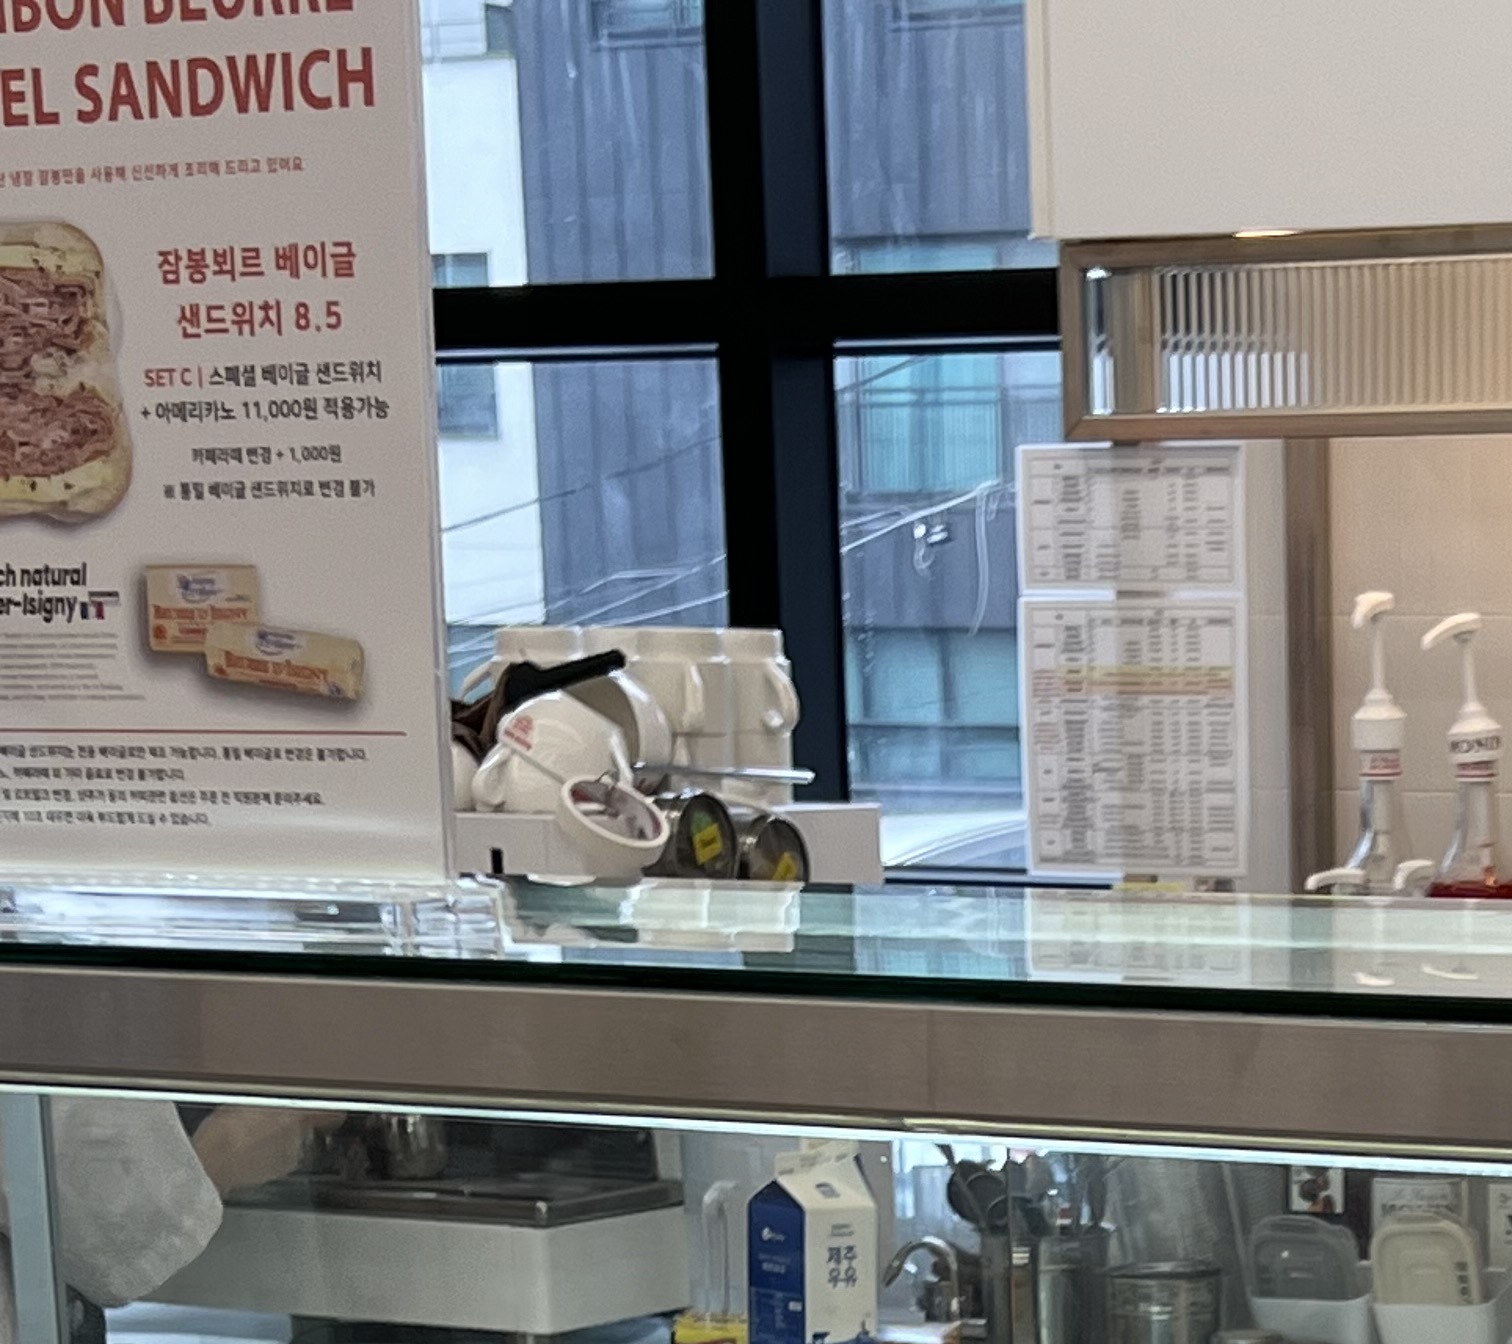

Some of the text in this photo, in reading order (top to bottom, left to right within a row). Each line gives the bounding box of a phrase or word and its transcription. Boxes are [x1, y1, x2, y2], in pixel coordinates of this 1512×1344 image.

[1, 47, 375, 126] EL SANDWICH
[131, 163, 179, 181] 신선하게
[158, 241, 356, 284] 잠봉뵈르 베이글
[178, 299, 342, 339] 샌드위치 8.5
[144, 360, 382, 388] SET C 스페셜 베이글 샌드위치
[155, 400, 236, 424] 아메리카노
[242, 398, 318, 422] 11,000원
[323, 396, 390, 420] 적용가능
[246, 446, 271, 465] 변경
[208, 481, 247, 500] 베이글
[318, 480, 344, 498] 변경
[20, 562, 87, 587] natural
[827, 1245, 858, 1266] 제주
[828, 1266, 858, 1289] 우유
